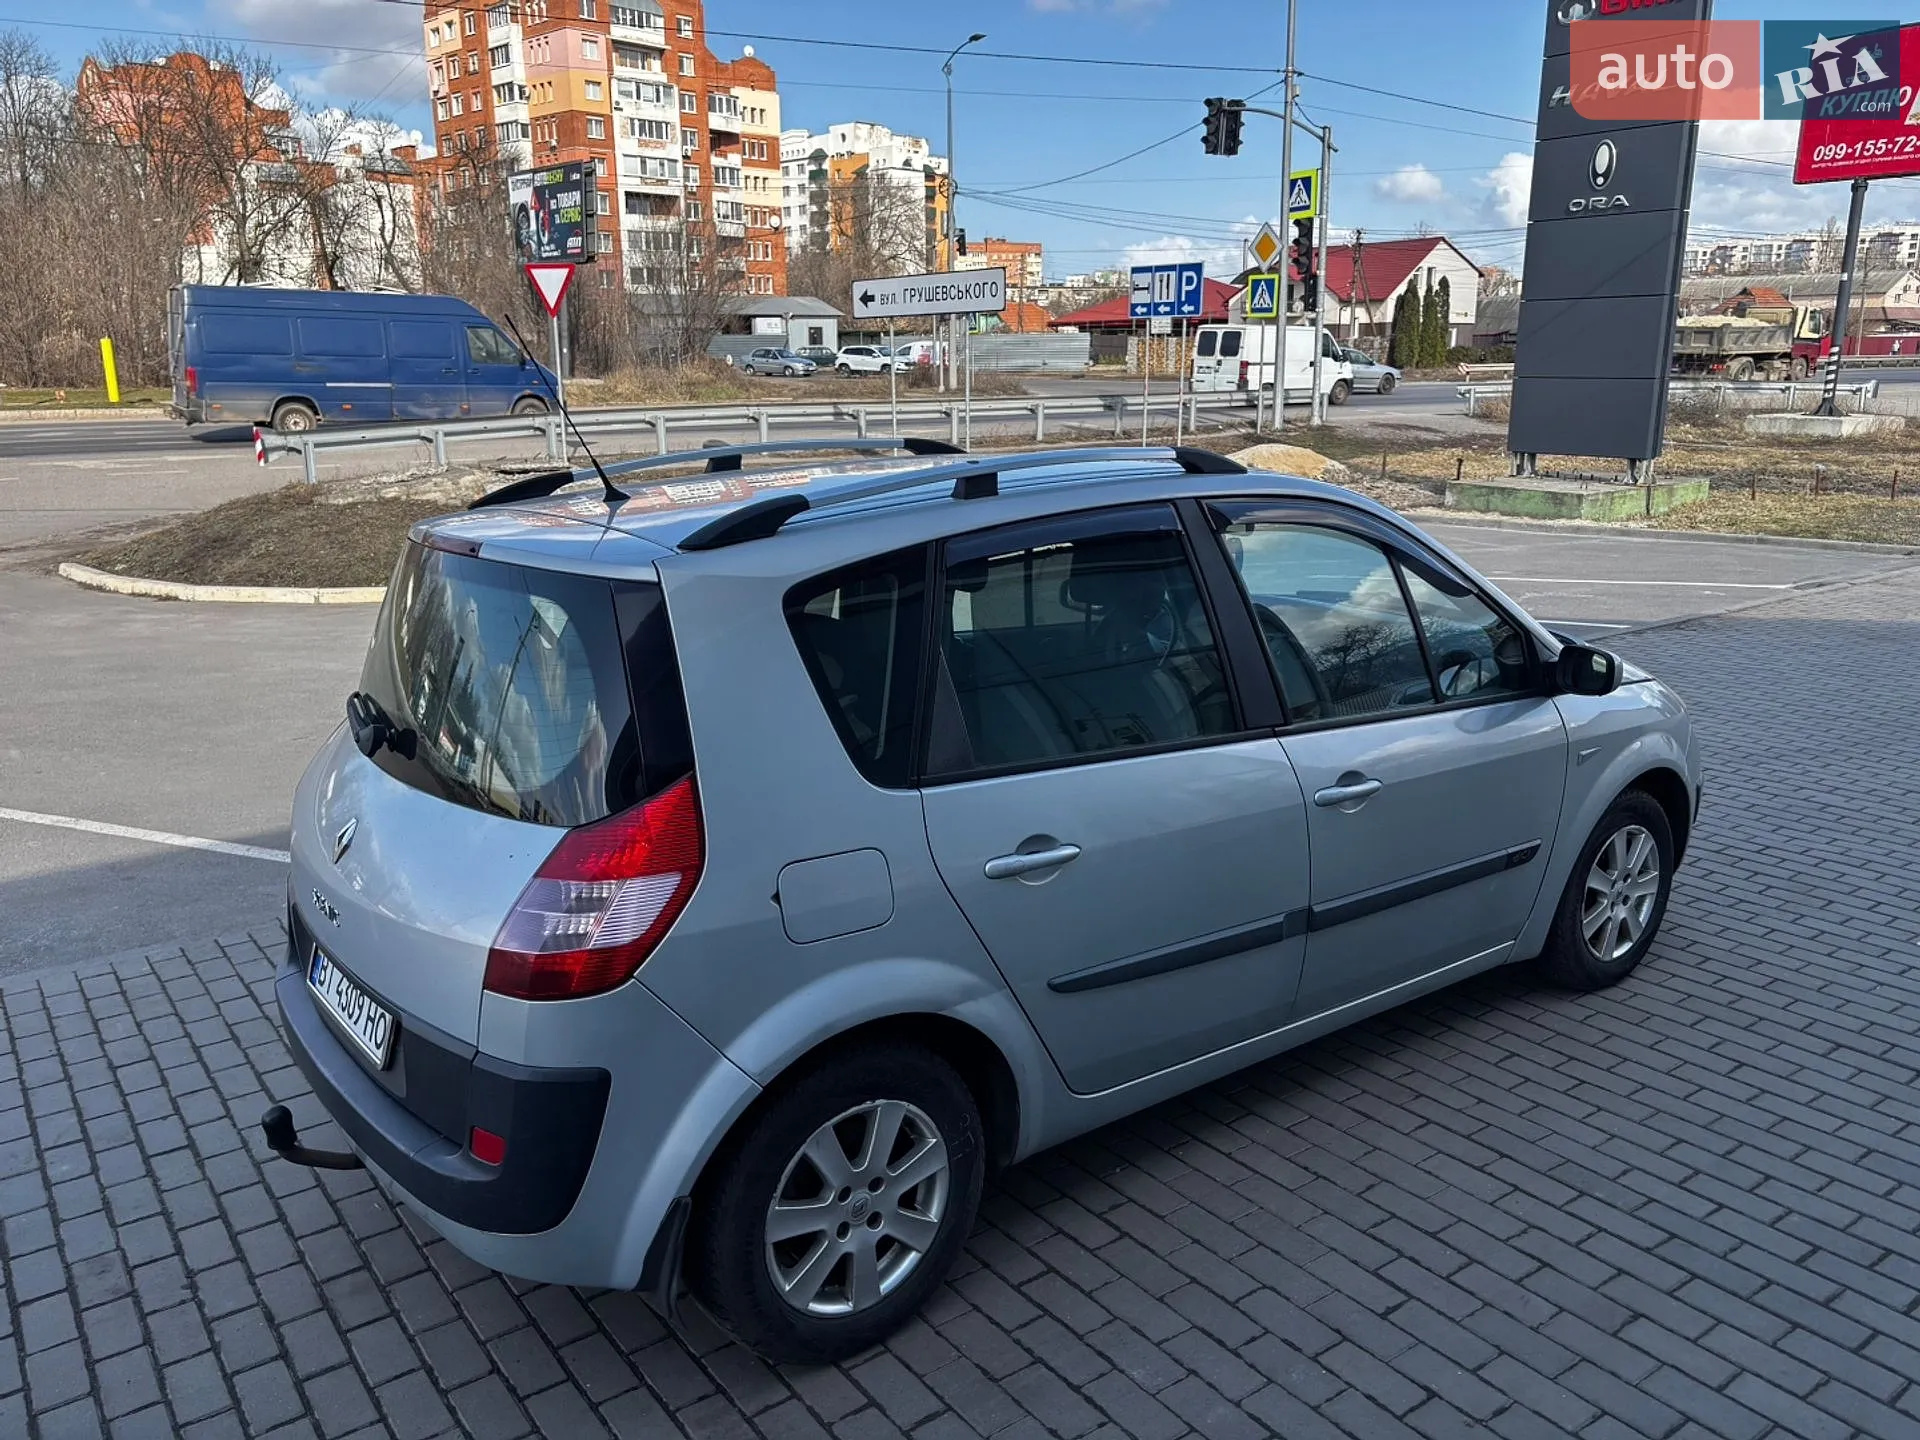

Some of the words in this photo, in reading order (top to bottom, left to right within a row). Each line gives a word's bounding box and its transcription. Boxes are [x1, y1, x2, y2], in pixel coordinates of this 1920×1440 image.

[1568, 194, 1630, 212] ORA
[903, 281, 999, 304] ГРУШЕВСЬКОГО
[1181, 271, 1198, 302] P
[336, 975, 366, 1026] 4309
